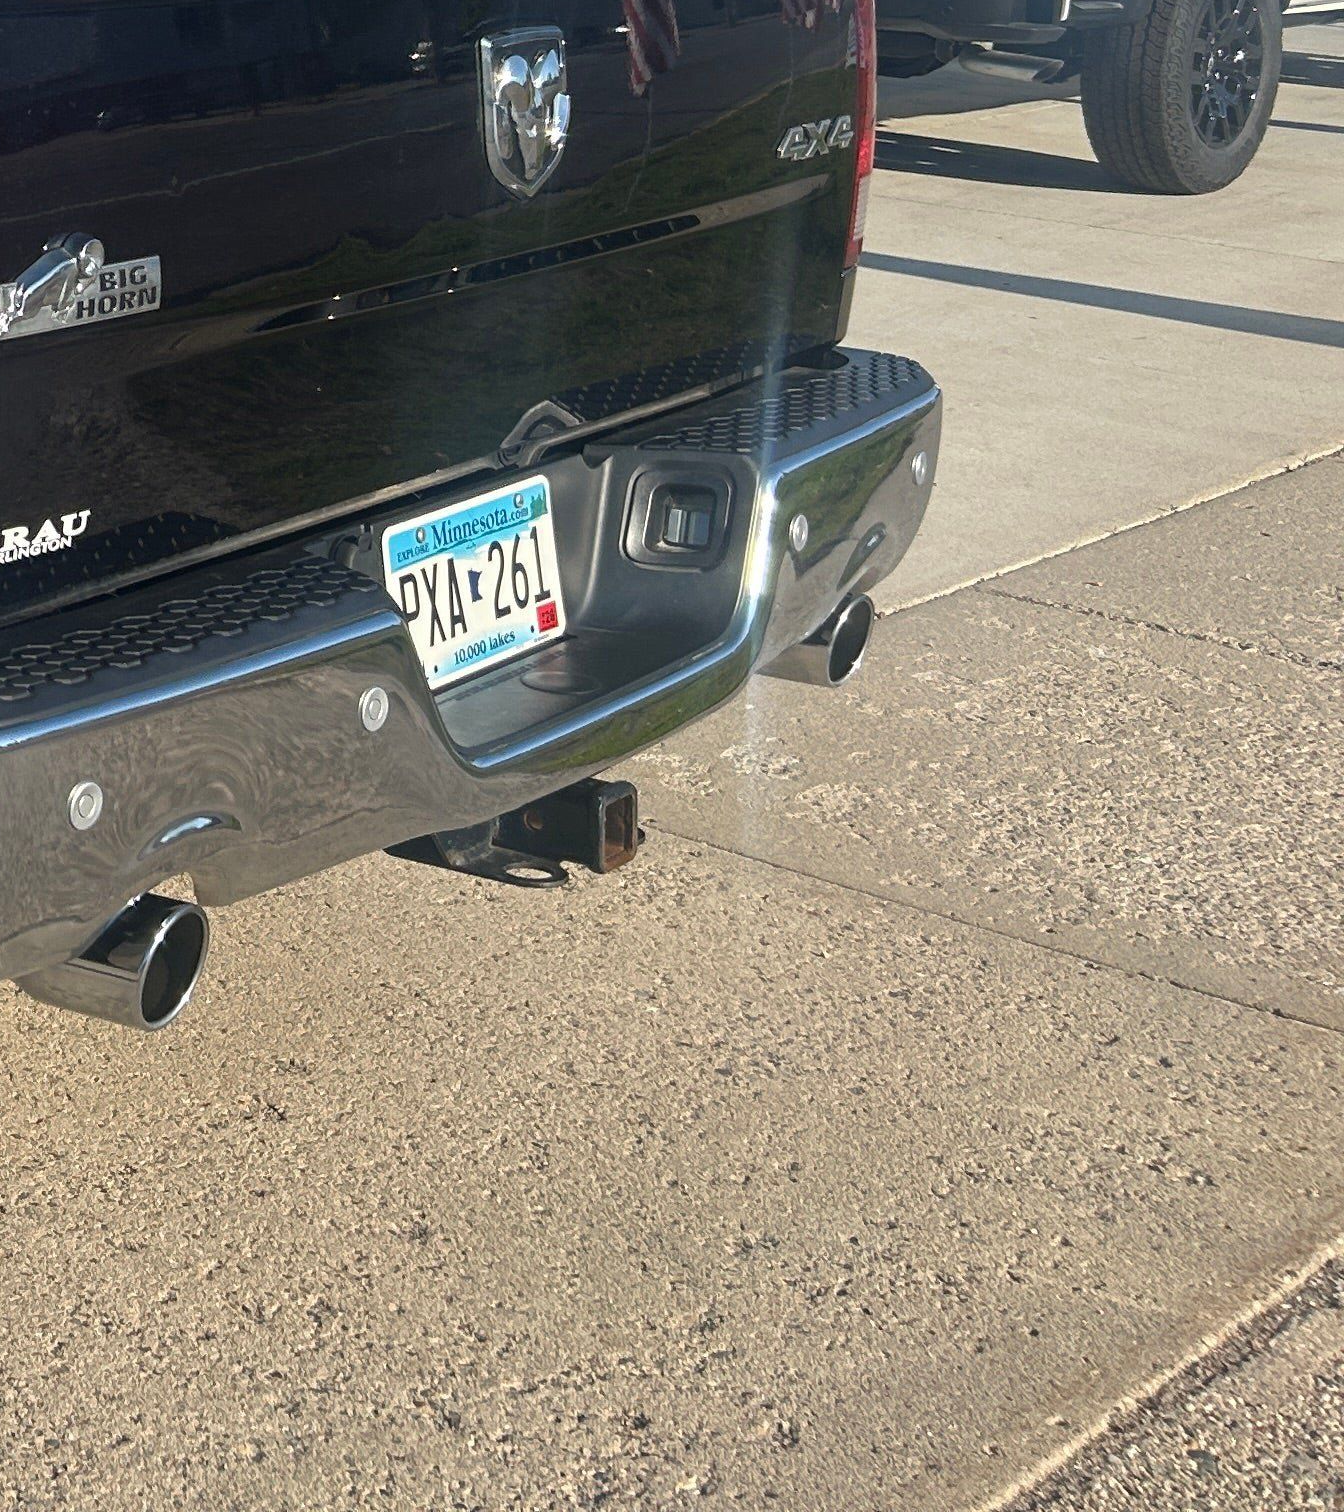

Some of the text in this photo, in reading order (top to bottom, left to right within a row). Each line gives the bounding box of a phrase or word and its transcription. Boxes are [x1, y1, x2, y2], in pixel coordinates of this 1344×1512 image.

[100, 265, 148, 292] BIG
[75, 285, 158, 320] HORN
[398, 525, 552, 648] PXA 261
[454, 641, 487, 667] 10,000
[489, 630, 516, 652] lakes
